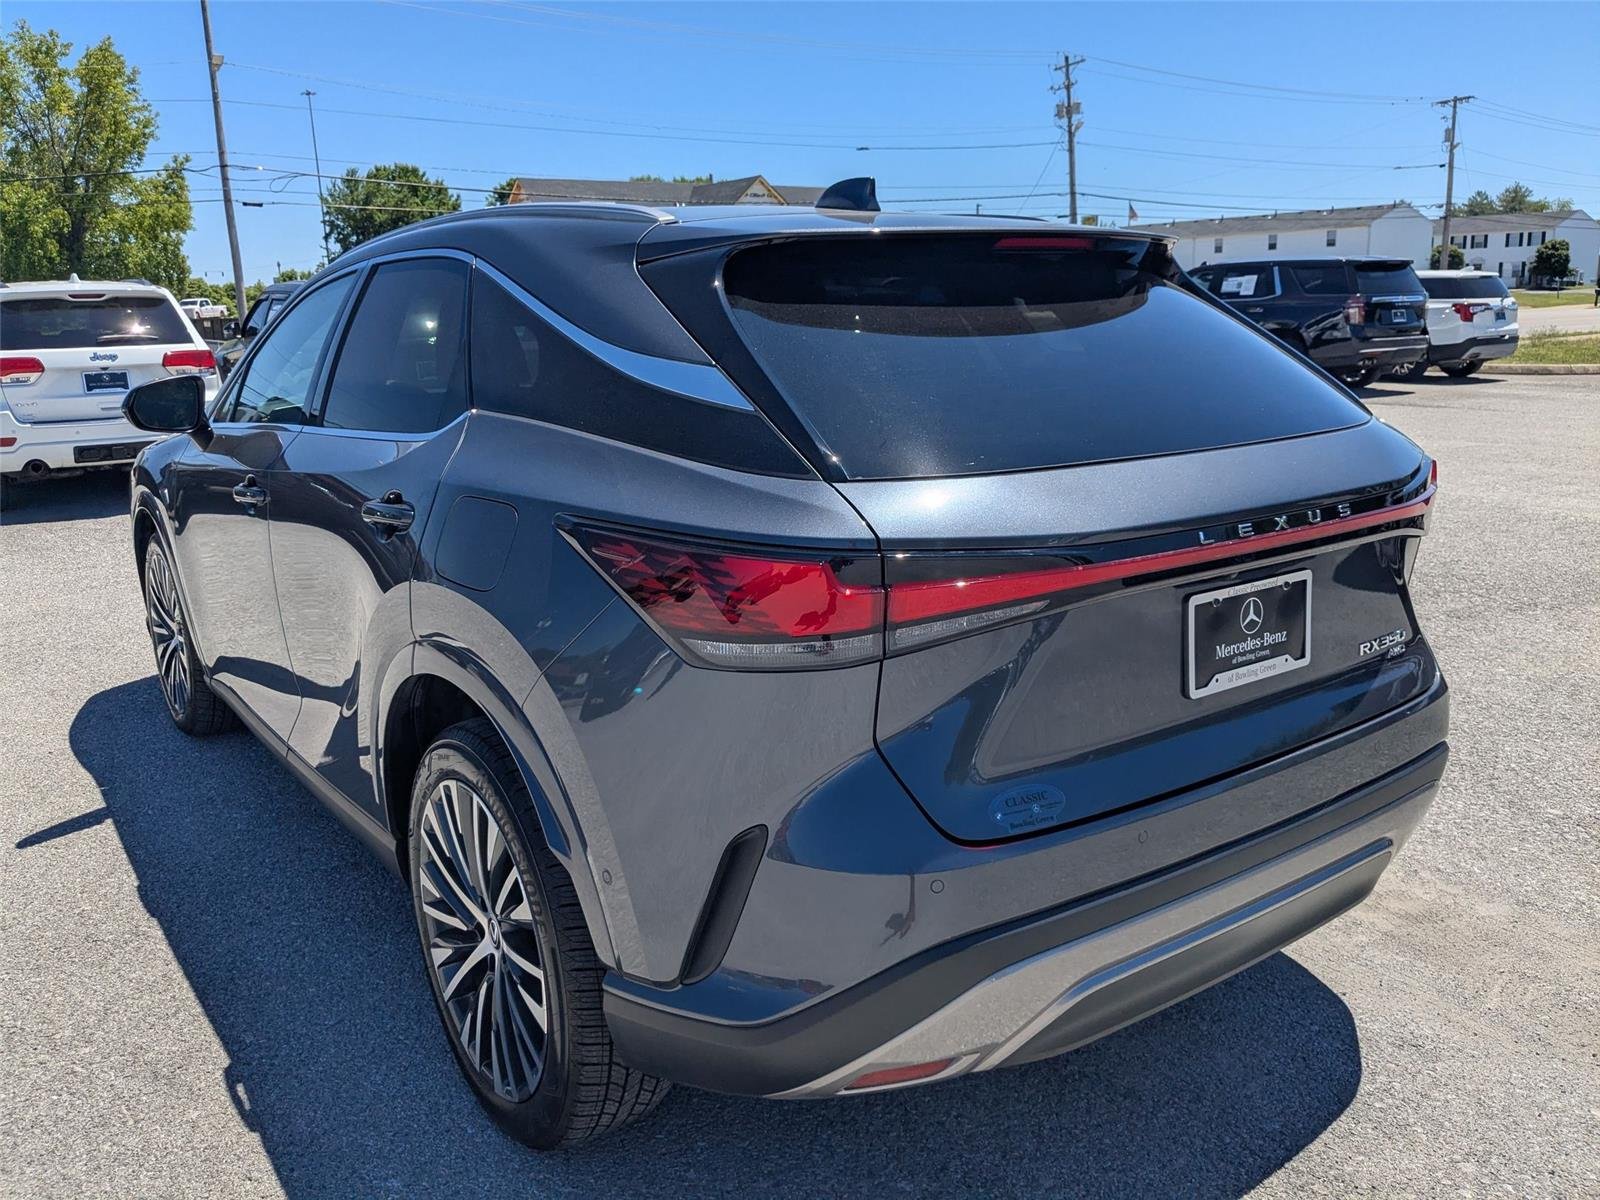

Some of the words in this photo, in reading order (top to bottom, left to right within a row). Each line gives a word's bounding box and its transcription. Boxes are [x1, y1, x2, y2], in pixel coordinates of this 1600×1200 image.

[1198, 503, 1351, 545] LEXUS
[1216, 631, 1287, 660] Mercedes-Benz
[1260, 663, 1277, 674] Green
[1004, 790, 1048, 808] CLASSIC
